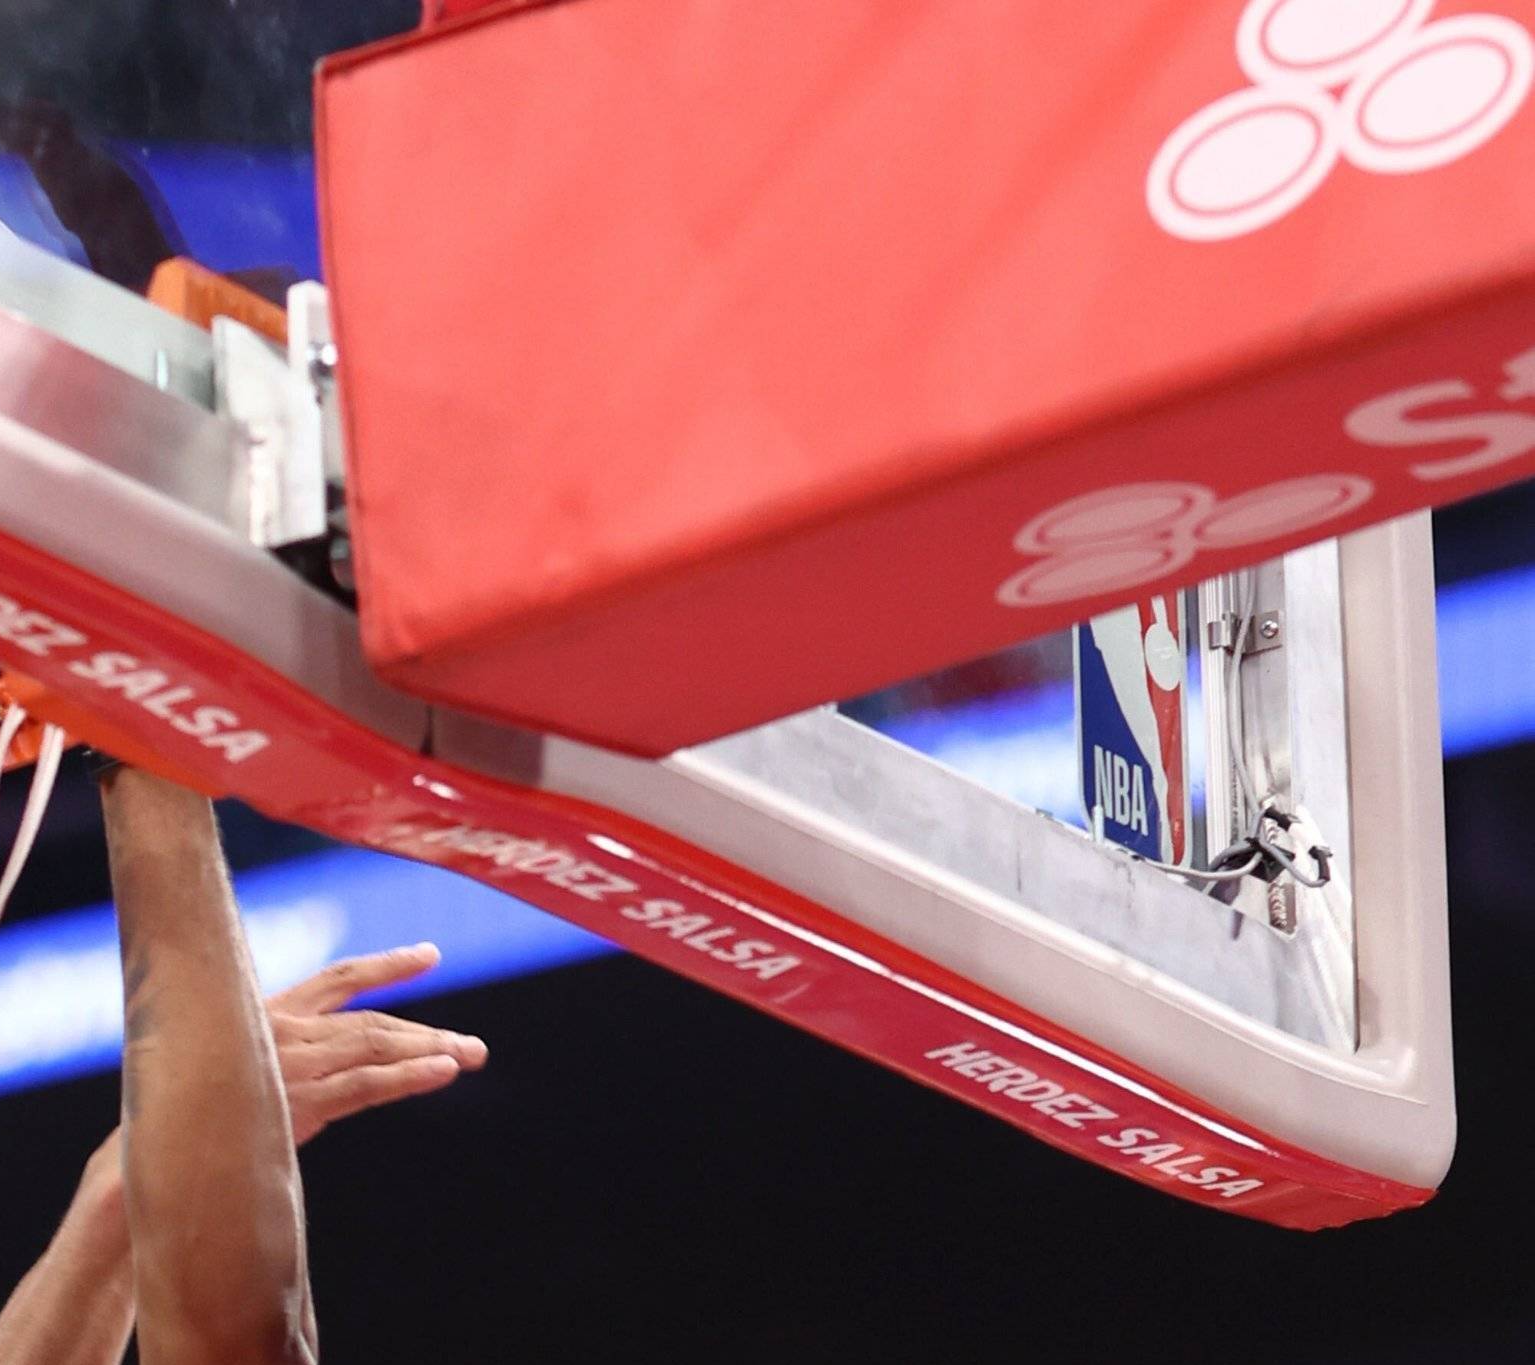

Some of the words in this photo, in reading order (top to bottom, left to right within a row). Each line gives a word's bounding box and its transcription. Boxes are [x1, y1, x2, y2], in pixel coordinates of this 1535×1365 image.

[68, 651, 271, 763] SALSA
[1094, 744, 1149, 837] NBA
[620, 898, 802, 980] SALSA
[924, 1042, 1120, 1130] HERDEZ
[1096, 1127, 1265, 1198] SALSA
